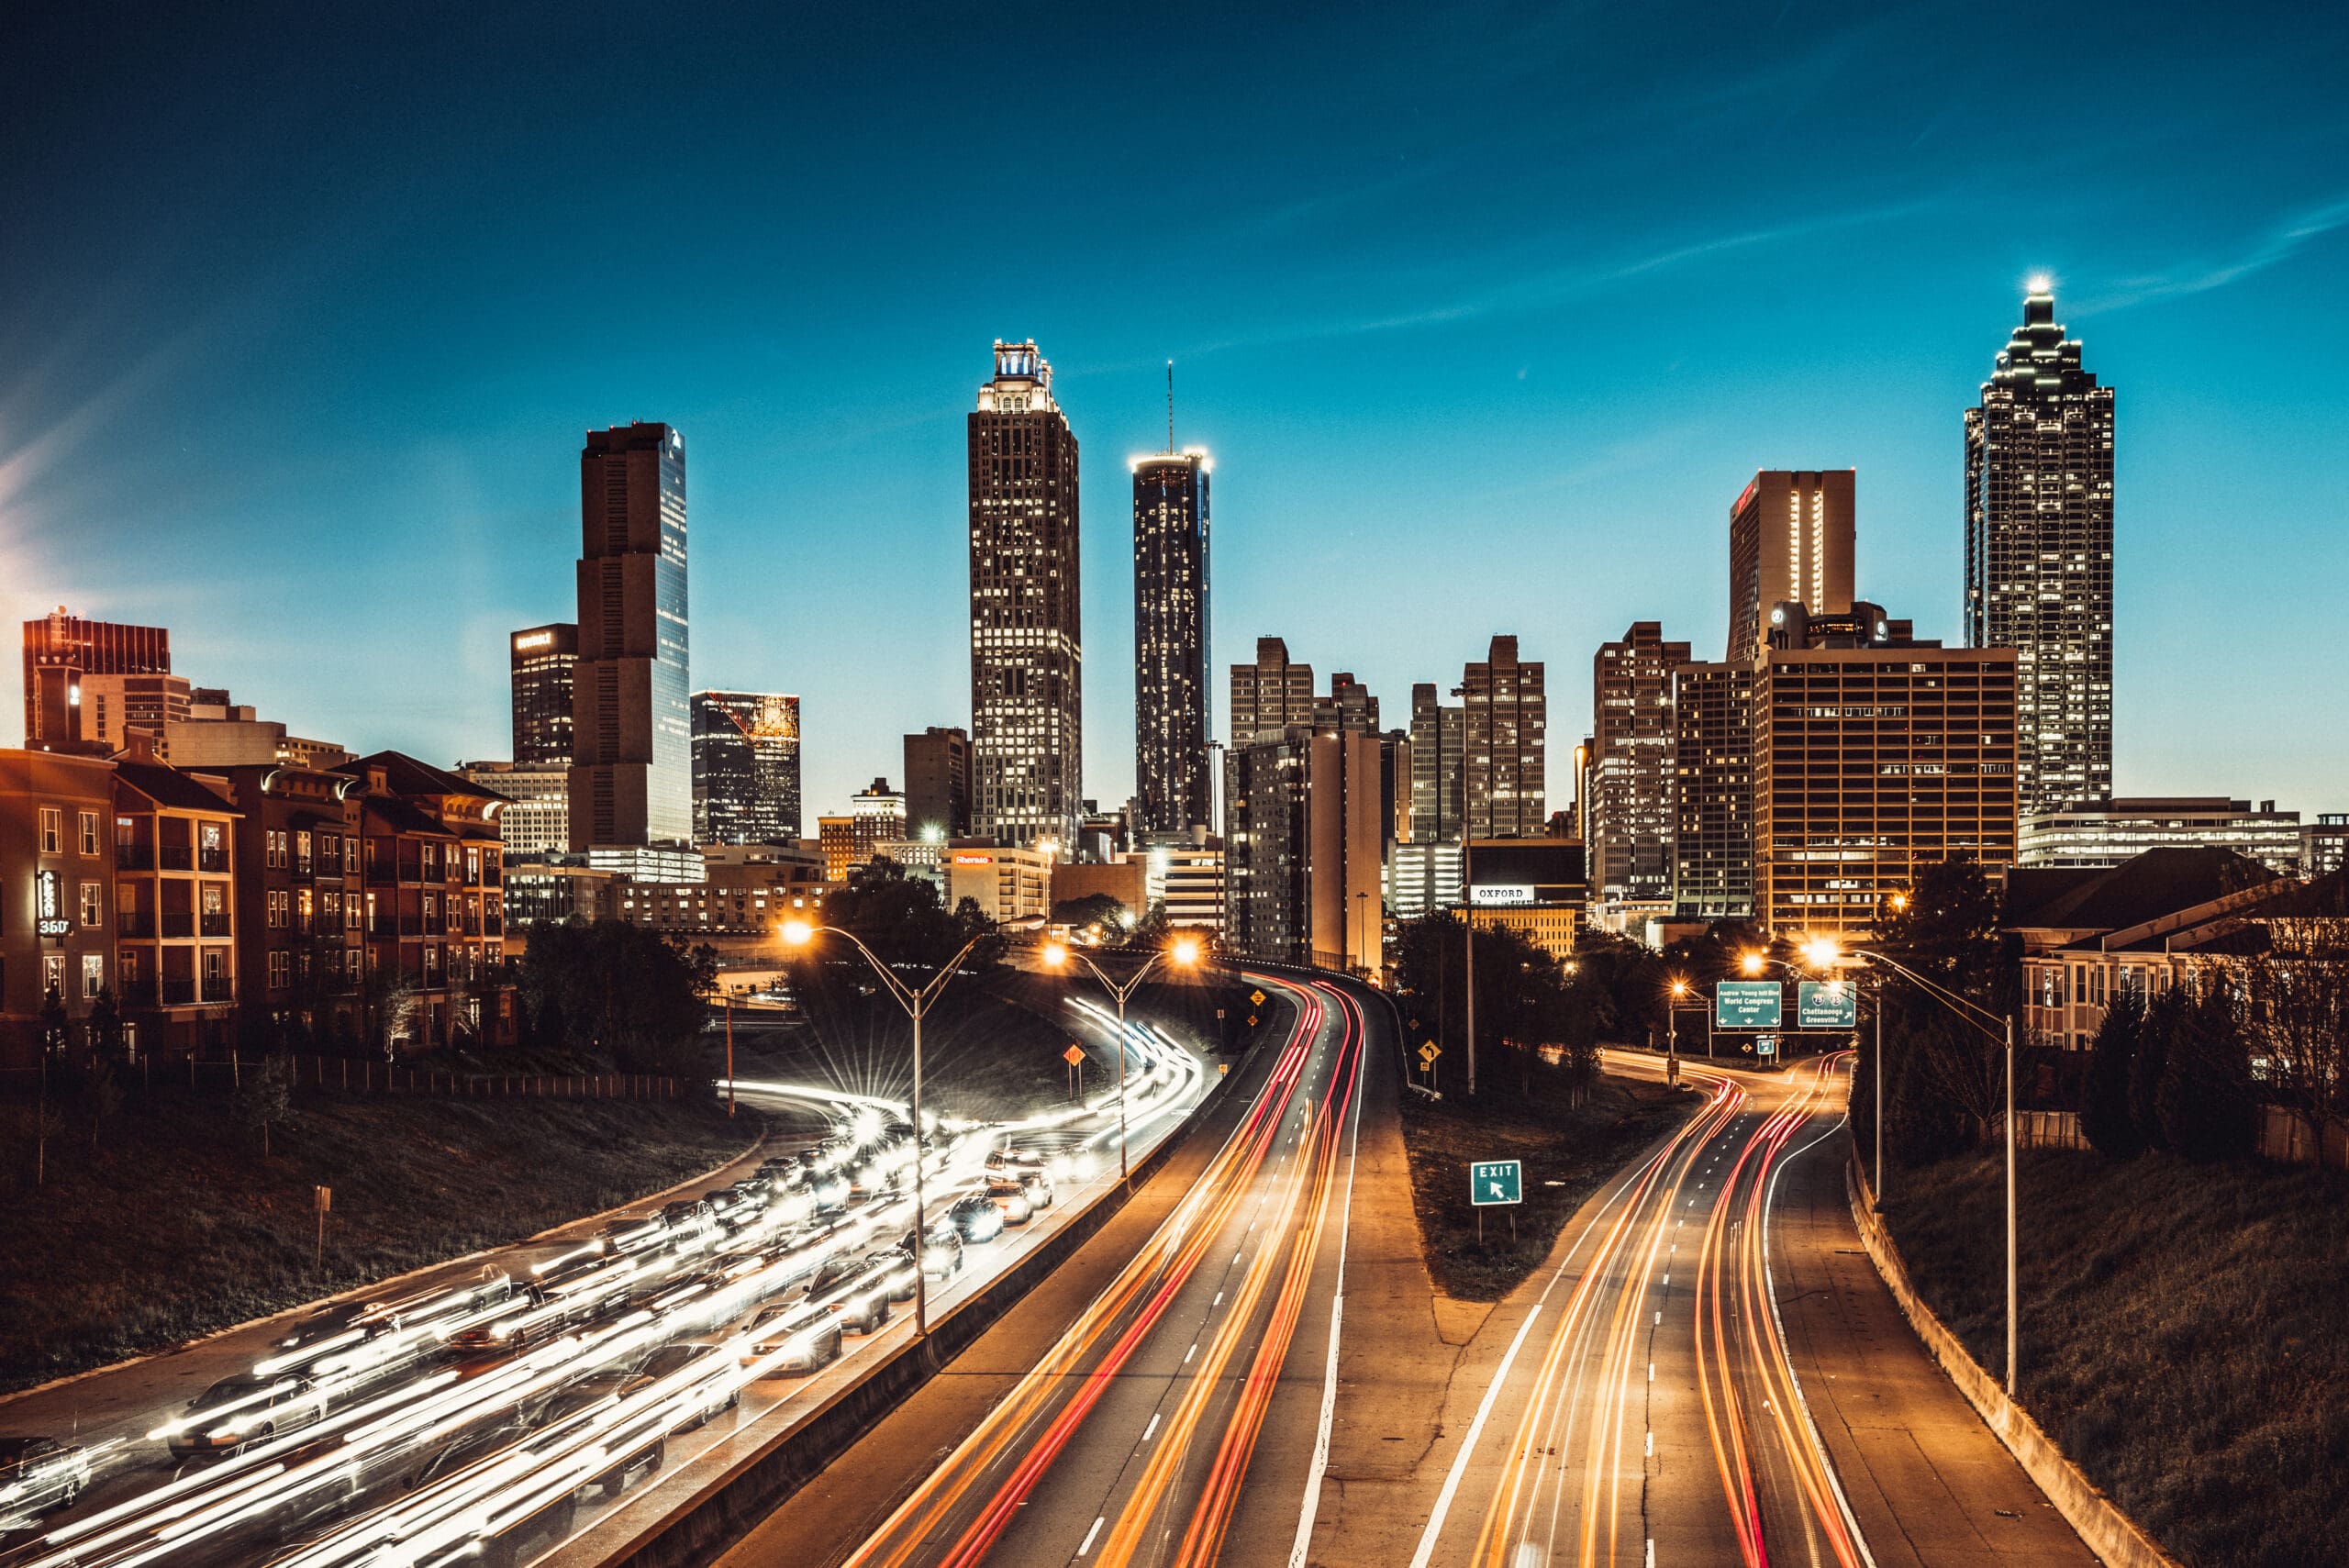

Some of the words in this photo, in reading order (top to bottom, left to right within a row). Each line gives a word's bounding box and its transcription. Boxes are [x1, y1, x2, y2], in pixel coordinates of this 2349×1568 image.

[1479, 889, 1523, 897] OXFORD
[1802, 1008, 1843, 1017] Chattanooga
[1479, 1165, 1512, 1177] EXIT
